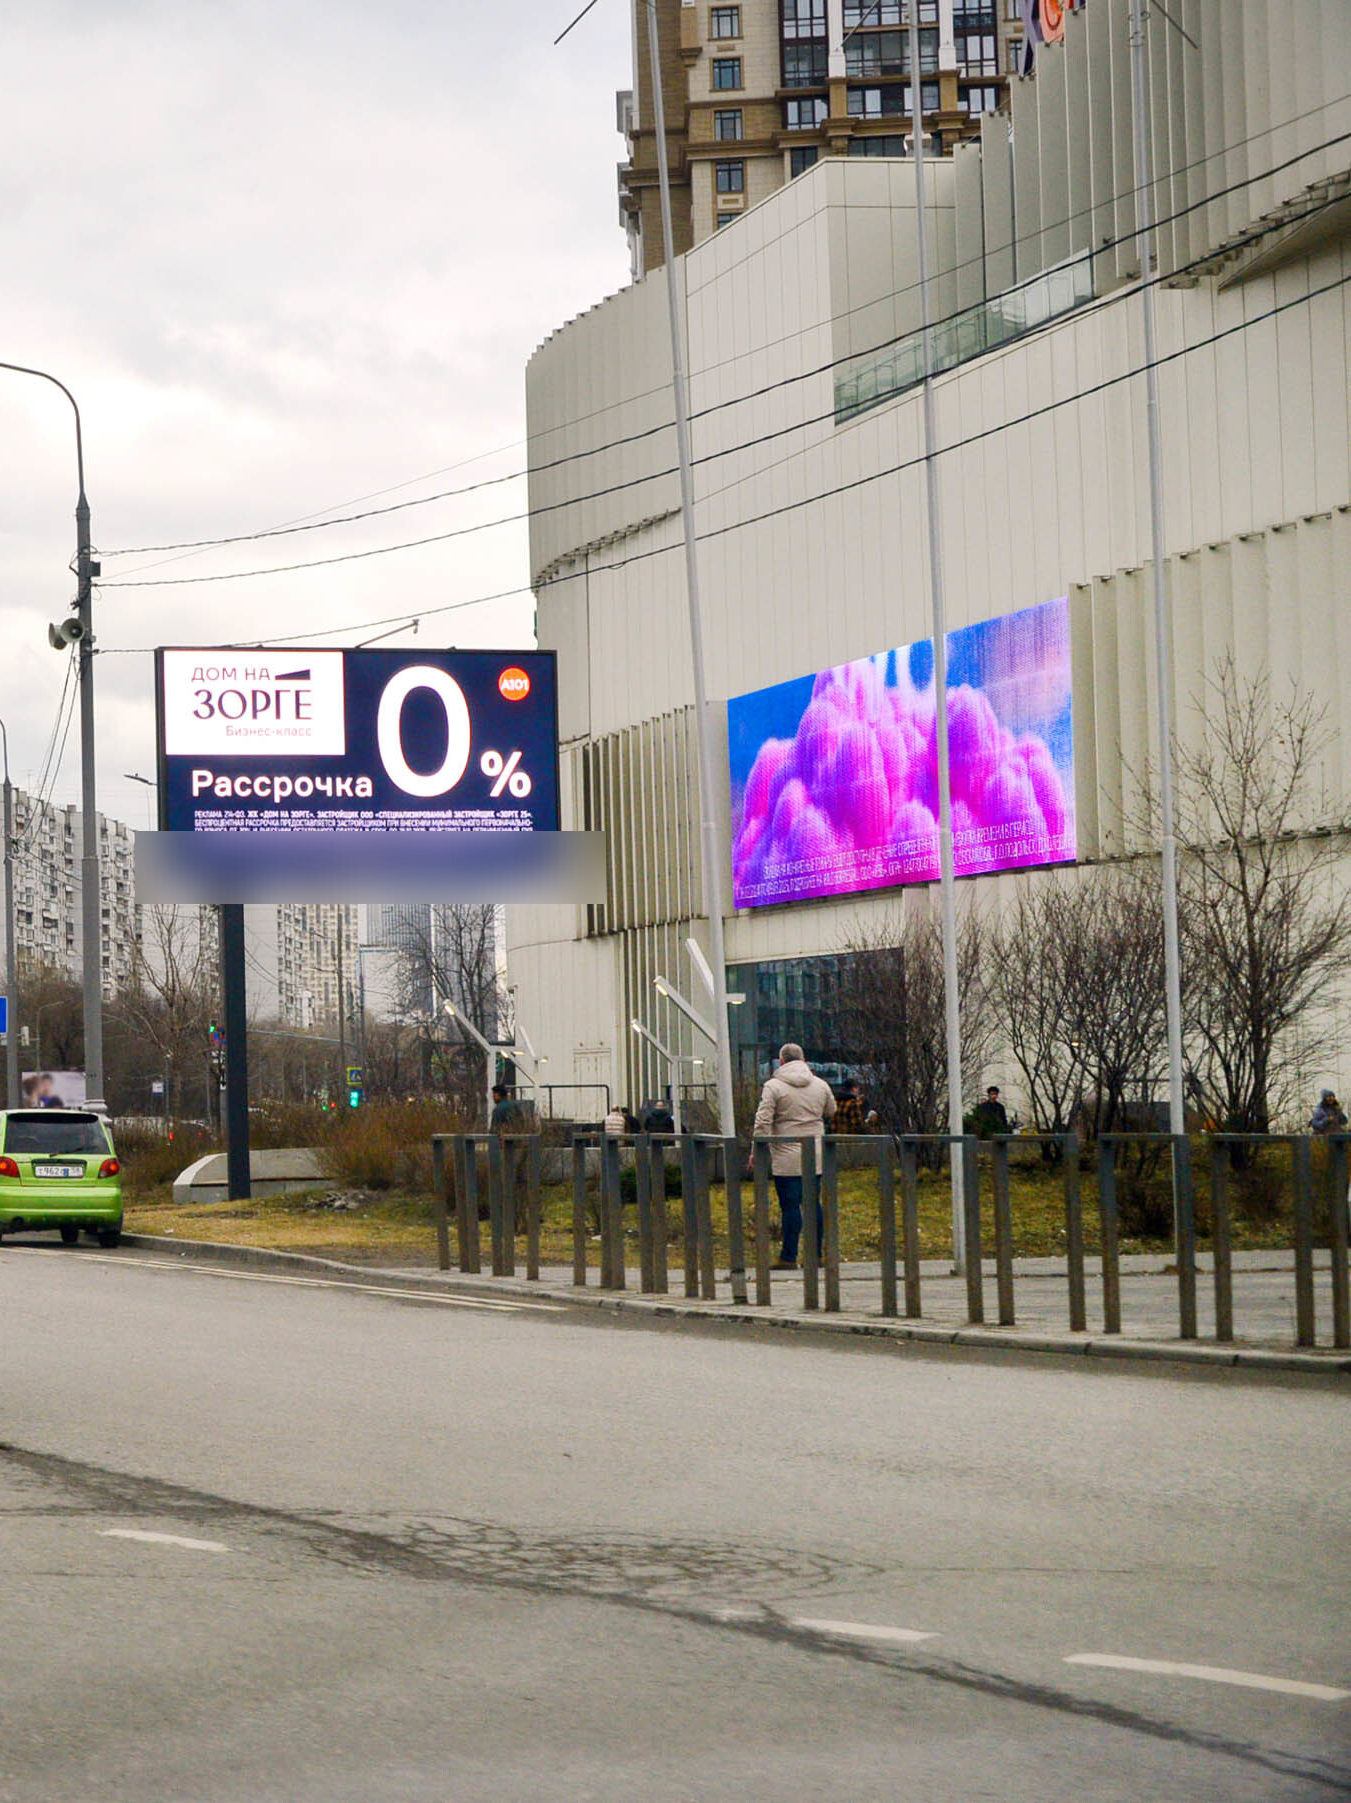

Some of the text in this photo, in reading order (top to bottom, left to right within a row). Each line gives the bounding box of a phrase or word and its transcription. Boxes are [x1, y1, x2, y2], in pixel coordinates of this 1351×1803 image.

[191, 667, 270, 682] ДОМ НА
[500, 679, 529, 691] А101
[193, 689, 312, 720] ЗОРГЕ
[225, 725, 312, 737] Бизнес-класс
[191, 770, 373, 803] Рассрочка
